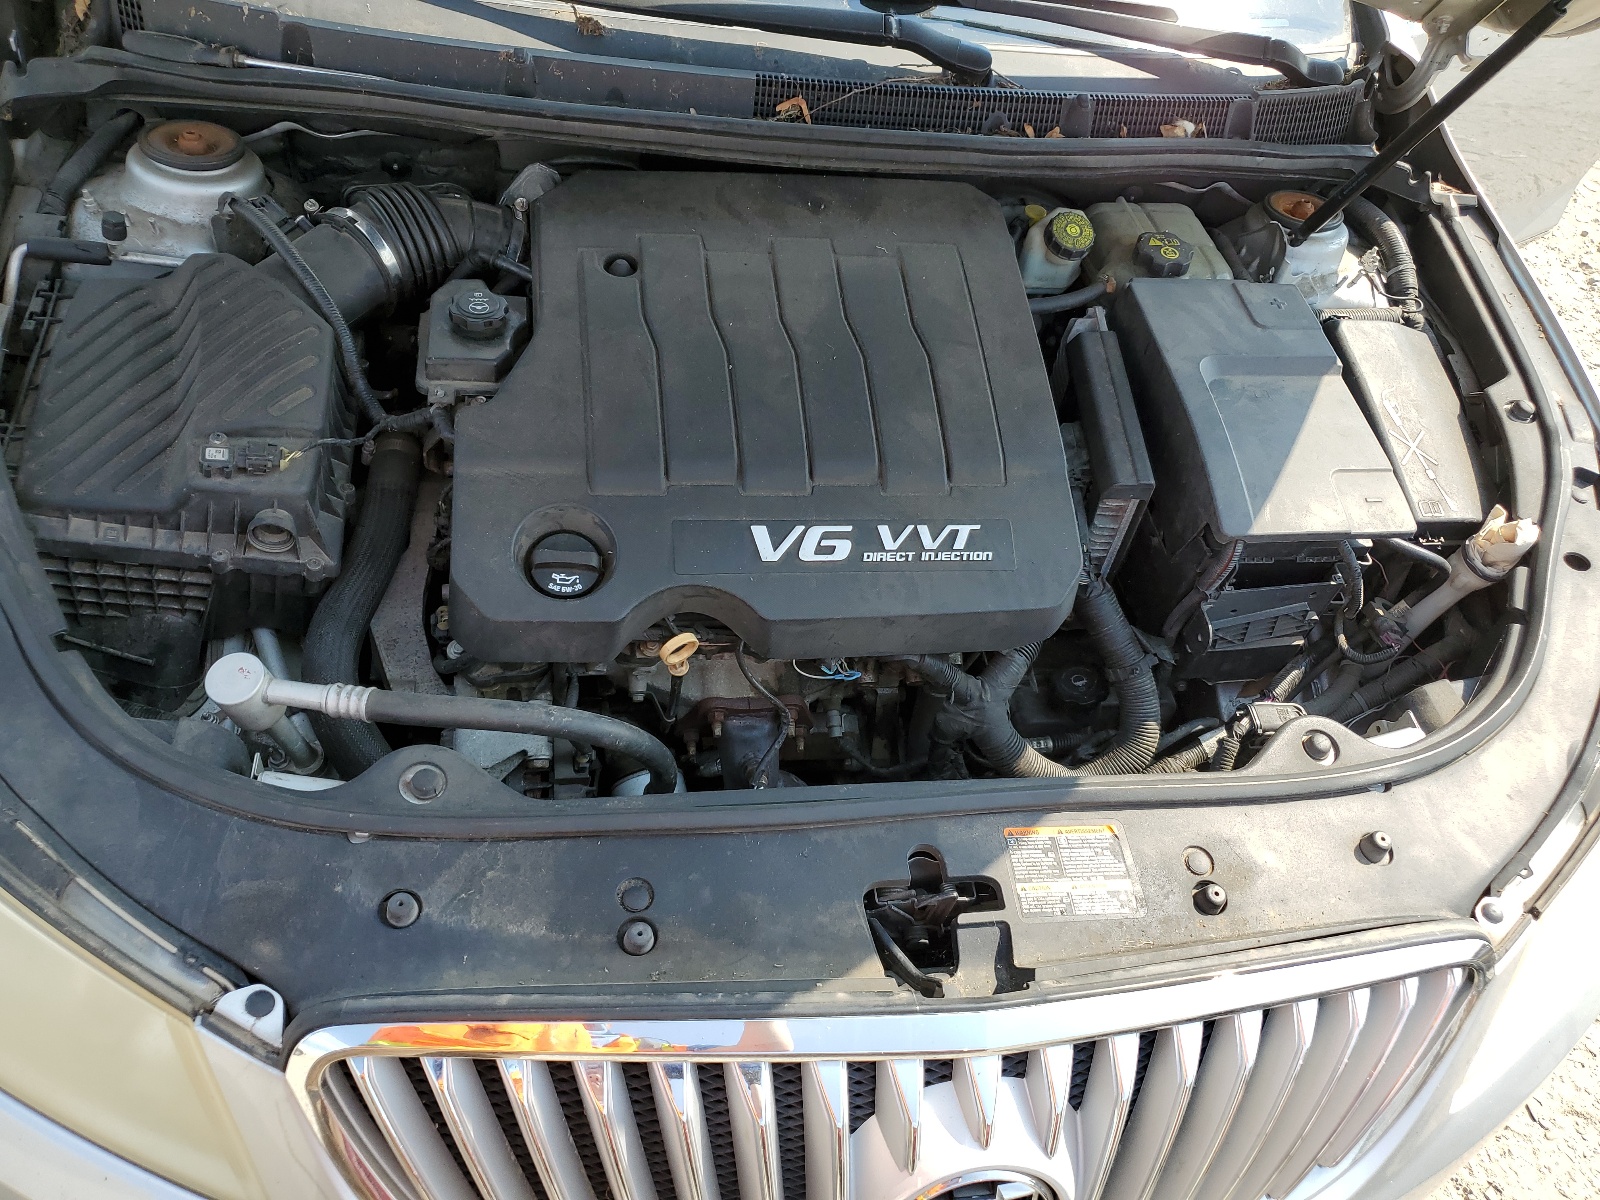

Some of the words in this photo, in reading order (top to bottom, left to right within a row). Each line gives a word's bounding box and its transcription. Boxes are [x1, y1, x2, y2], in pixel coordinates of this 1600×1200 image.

[750, 525, 853, 562] V6
[877, 524, 981, 550] VVT
[863, 551, 916, 562] DIRECT
[921, 551, 993, 561] INJECTION
[548, 582, 561, 592] SAE
